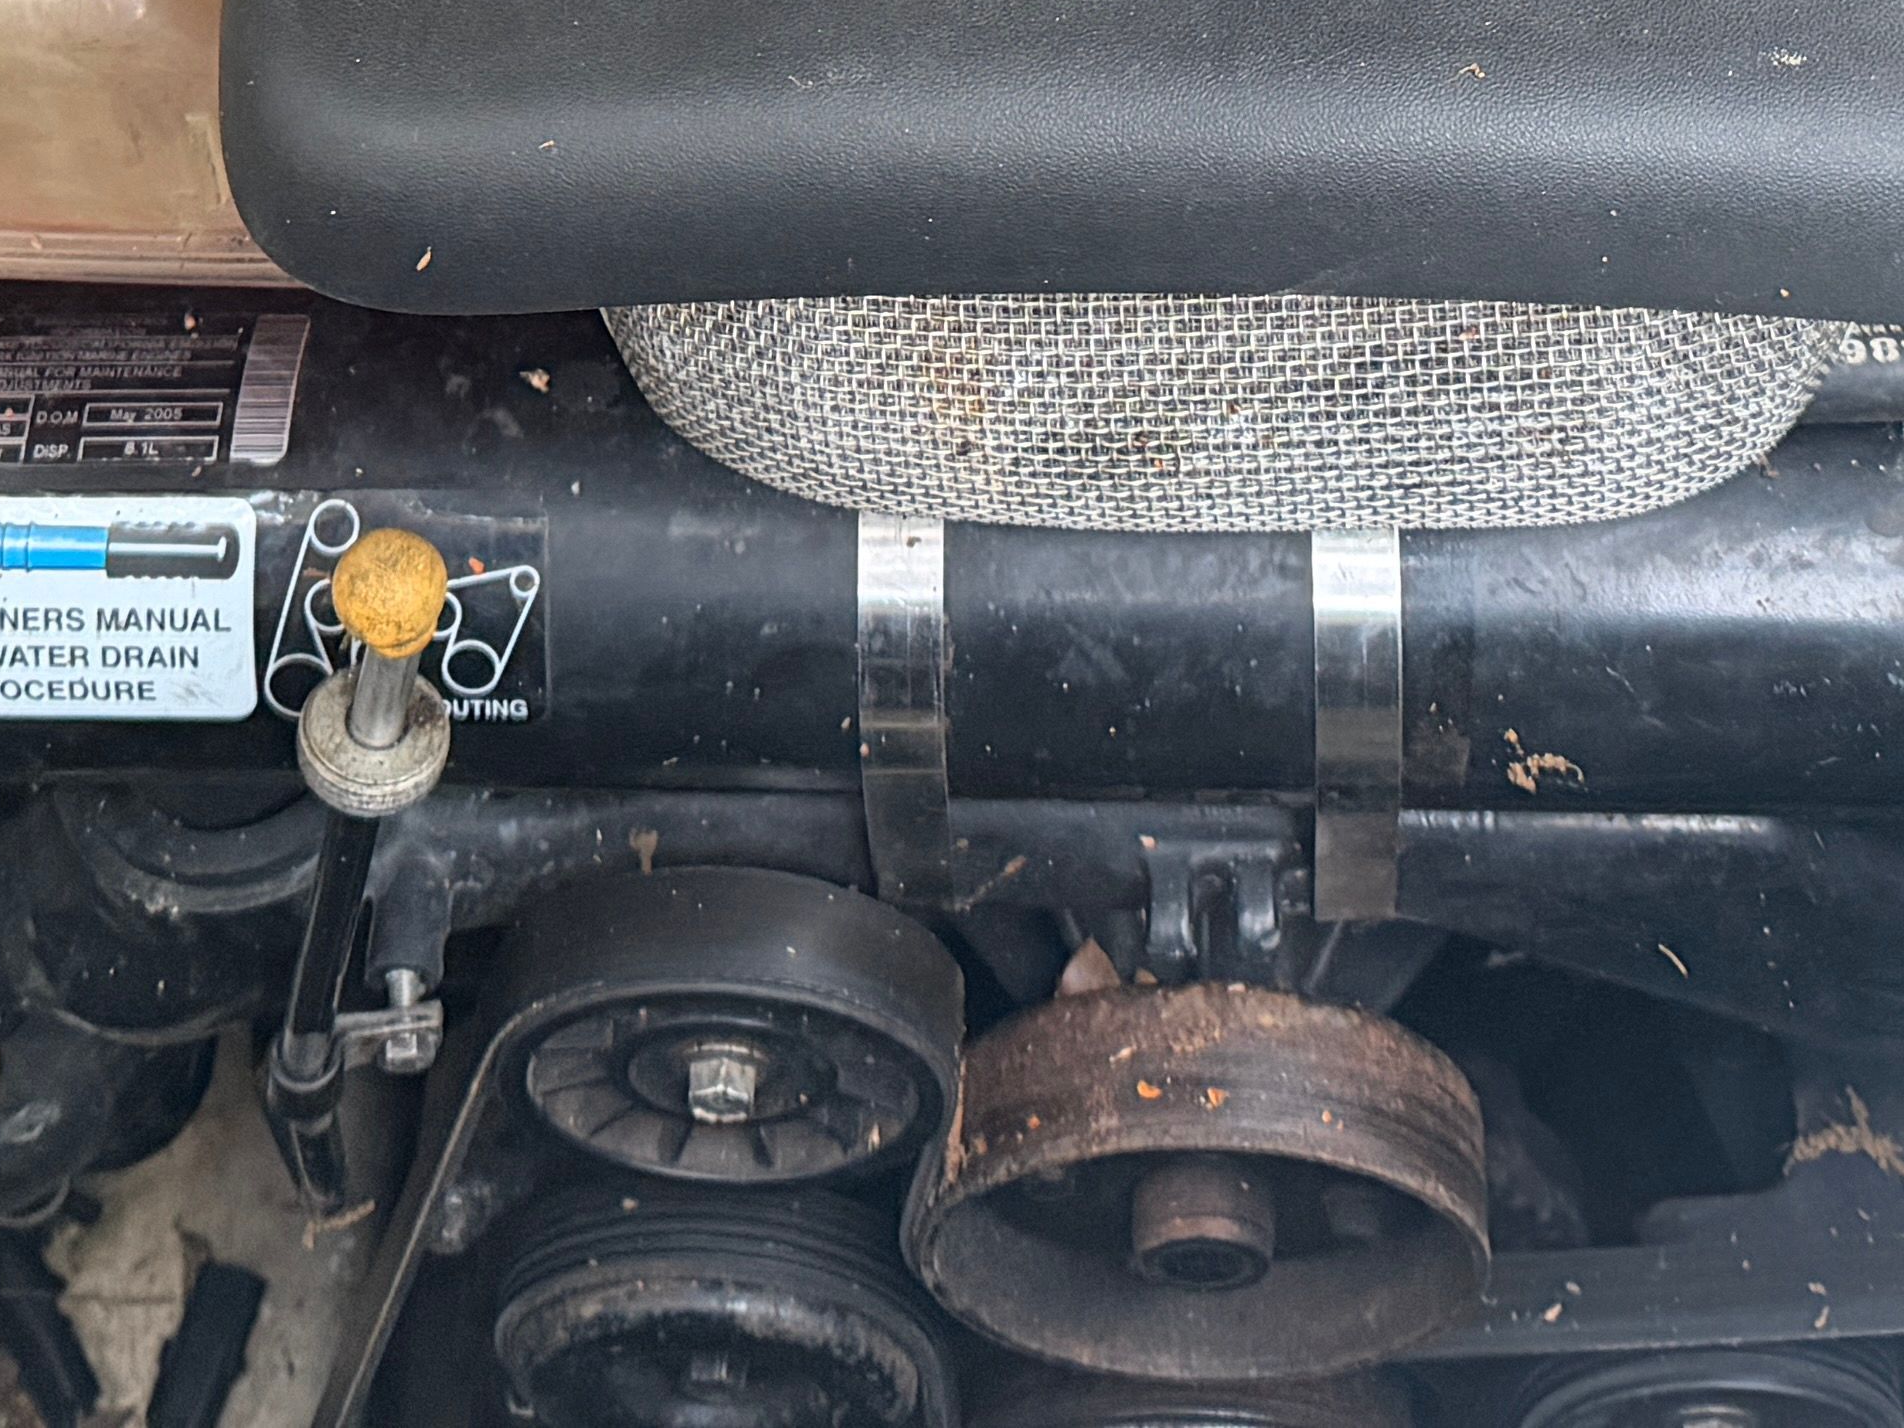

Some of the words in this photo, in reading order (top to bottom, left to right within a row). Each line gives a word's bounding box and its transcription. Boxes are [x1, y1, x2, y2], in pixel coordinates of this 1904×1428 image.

[45, 366, 75, 377] FOR
[79, 366, 183, 378] MAINTENANCE
[110, 408, 137, 422] May
[144, 407, 183, 421] 2005
[96, 606, 233, 634] MANUAL
[100, 644, 199, 668] DRAIN
[440, 698, 530, 722] OUTING
